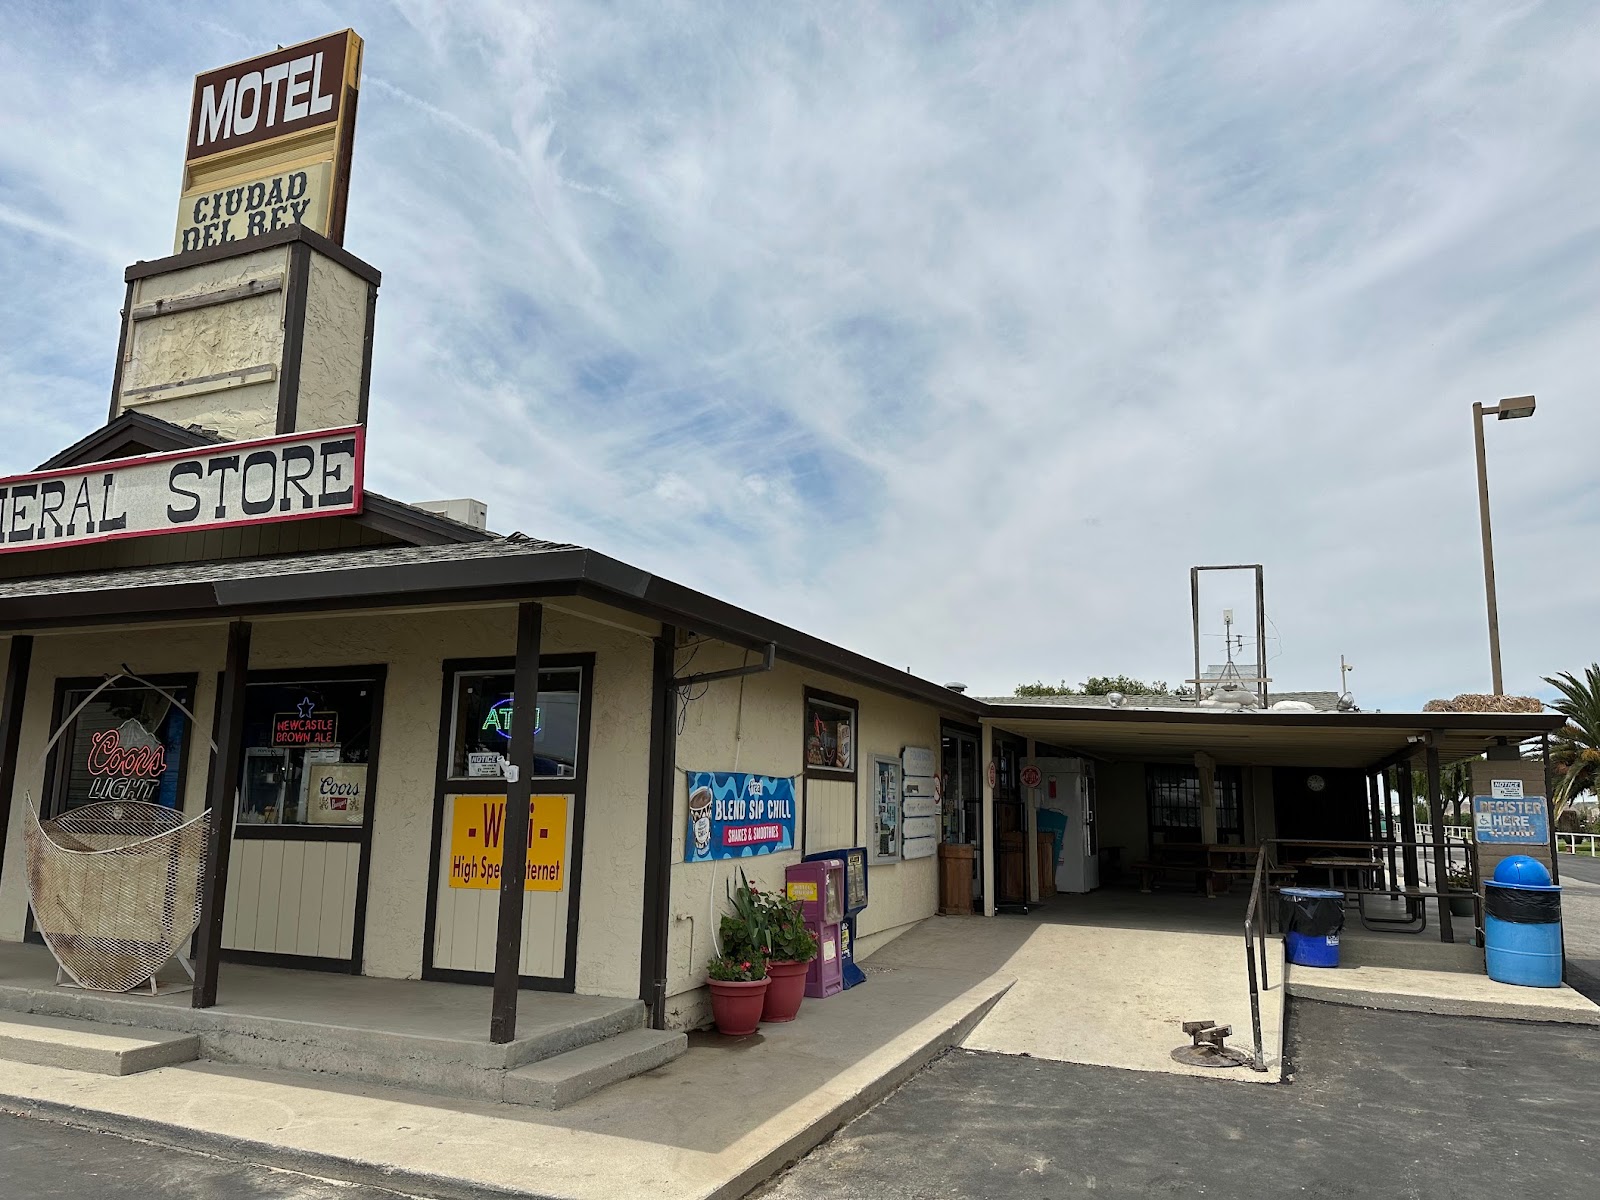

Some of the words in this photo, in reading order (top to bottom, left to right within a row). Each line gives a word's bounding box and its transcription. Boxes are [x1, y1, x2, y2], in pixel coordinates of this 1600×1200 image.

[197, 51, 332, 146] MOTEL
[193, 172, 307, 224] CIUDAD
[182, 219, 235, 250] DEL
[247, 198, 311, 236] REY
[167, 439, 355, 523] STORE
[277, 719, 333, 731] NEWCASTLE
[482, 708, 540, 729] AT
[276, 732, 311, 743] BROWN
[314, 731, 332, 743] ALE
[88, 729, 167, 777] Coors
[88, 777, 160, 801] LIGHT
[320, 776, 360, 796] Coors
[715, 800, 746, 821] BLEND
[749, 800, 764, 820] SIP
[767, 799, 791, 819] CHILL
[1480, 800, 1541, 814] REGISTER
[483, 802, 534, 849] Wi
[1493, 815, 1530, 826] HERE
[728, 828, 747, 843] SHAKES
[748, 827, 753, 841] &
[754, 826, 779, 841] SMOOTHIES
[453, 855, 478, 884] High
[481, 855, 501, 885] Spe
[527, 860, 560, 881] ternet
